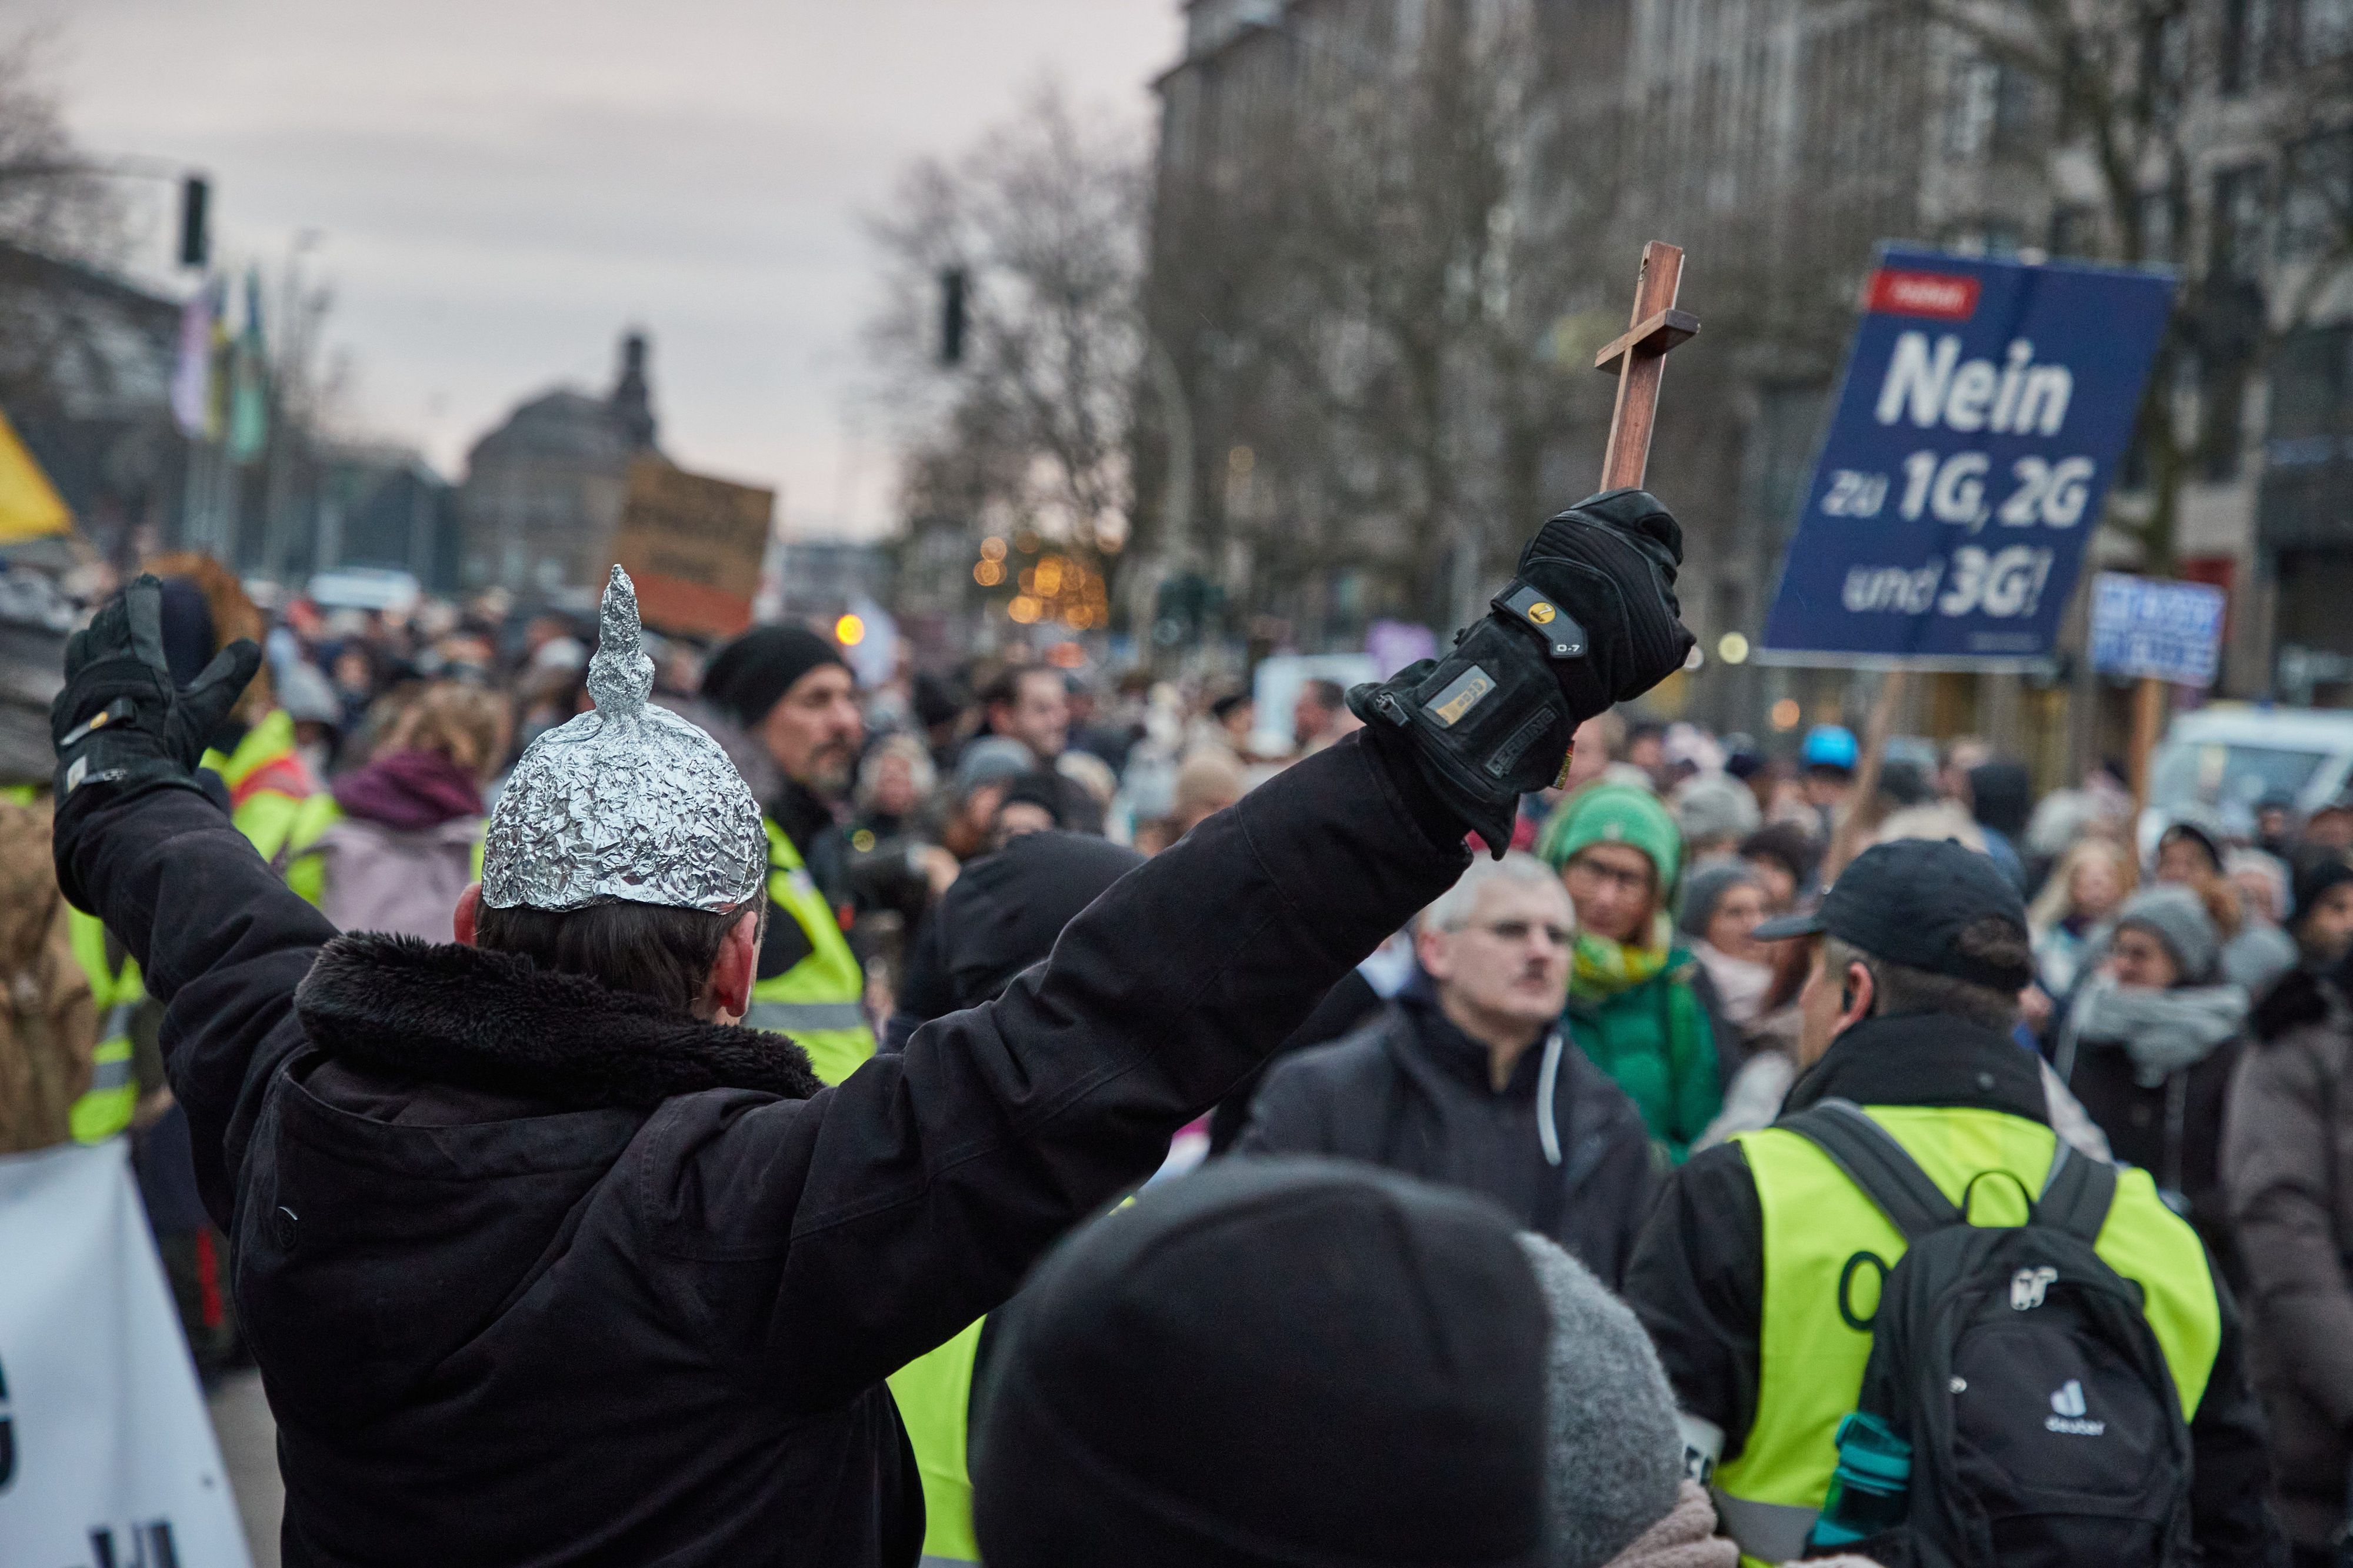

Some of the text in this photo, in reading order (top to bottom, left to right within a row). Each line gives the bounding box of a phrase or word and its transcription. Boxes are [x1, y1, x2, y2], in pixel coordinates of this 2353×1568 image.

[1875, 331, 2074, 436] Nein
[1822, 451, 2094, 534] zu 1G, 2G
[1539, 604, 1552, 615] 7
[1842, 545, 2054, 618] und 3G!
